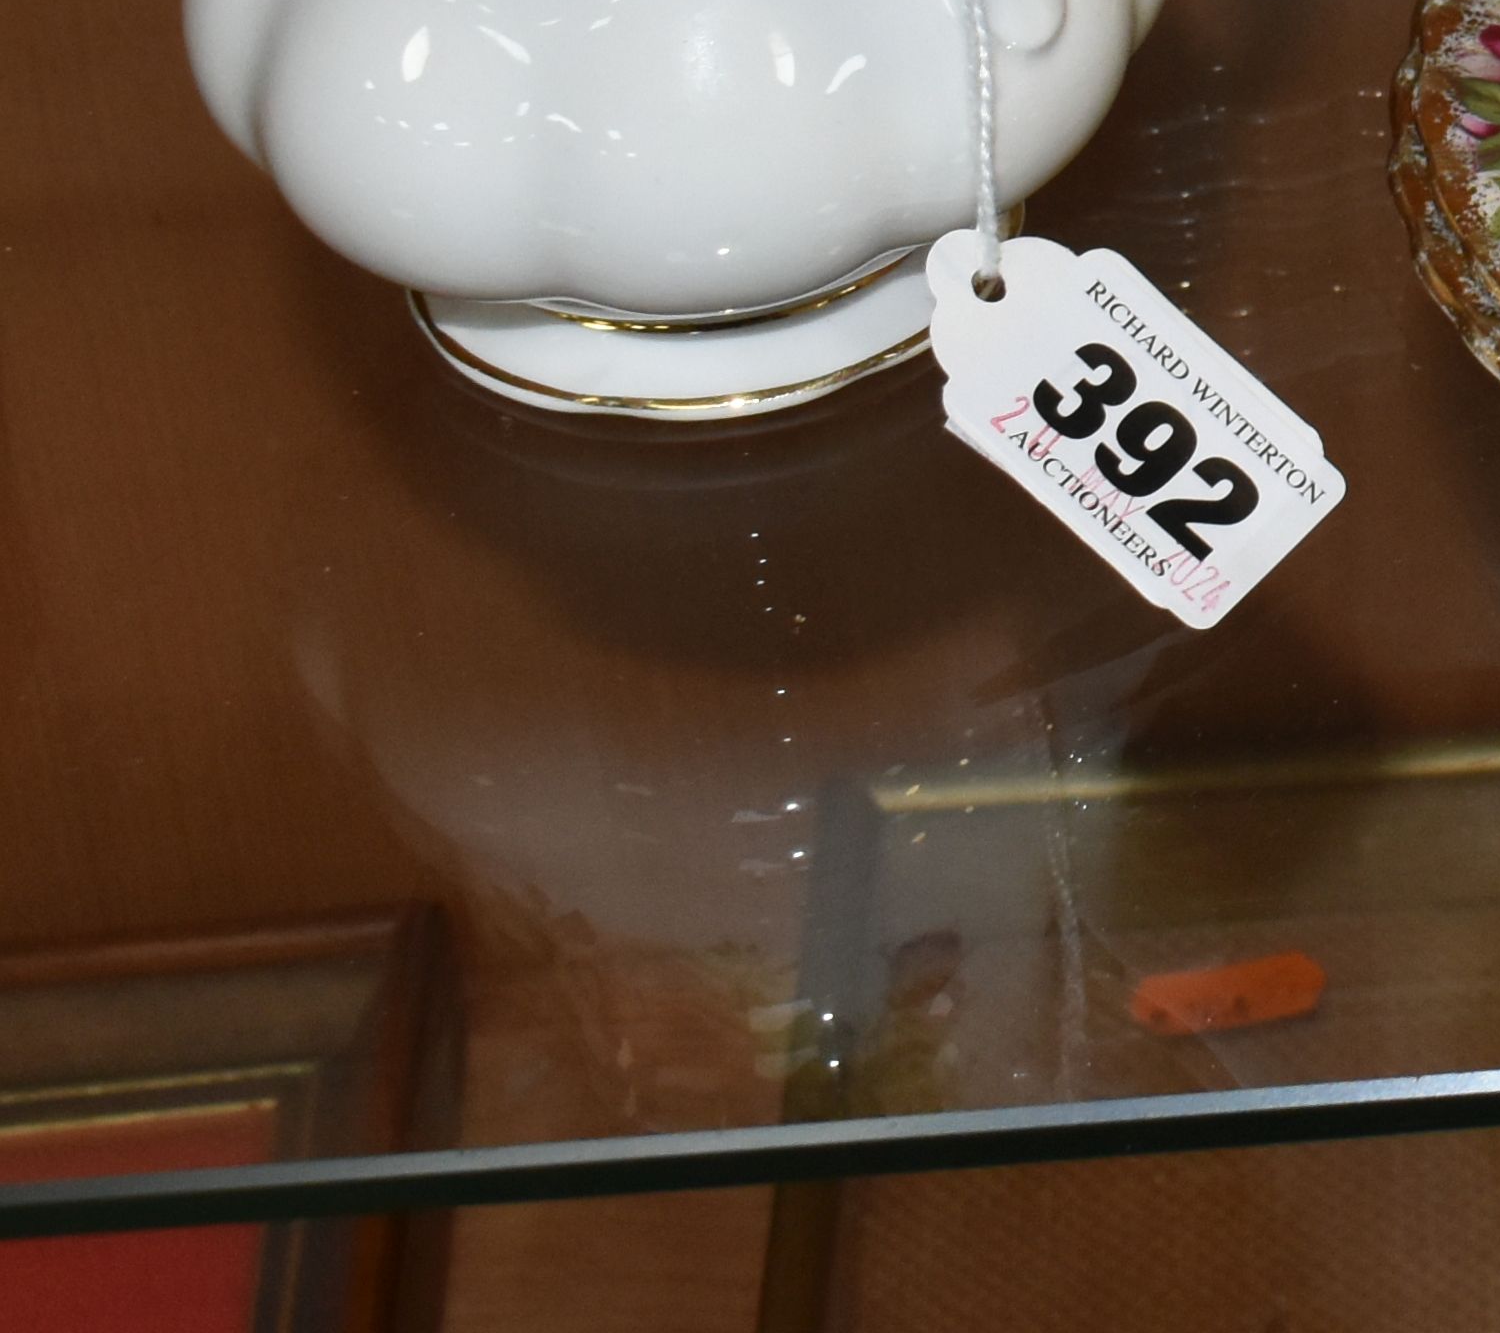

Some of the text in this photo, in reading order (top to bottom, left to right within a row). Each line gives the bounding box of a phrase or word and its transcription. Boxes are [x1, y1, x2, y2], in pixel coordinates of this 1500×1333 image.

[1032, 342, 1260, 562] 392
[1085, 279, 1326, 505] RICHARD WINTERTON
[1008, 429, 1172, 578] AUCTIONEERS
